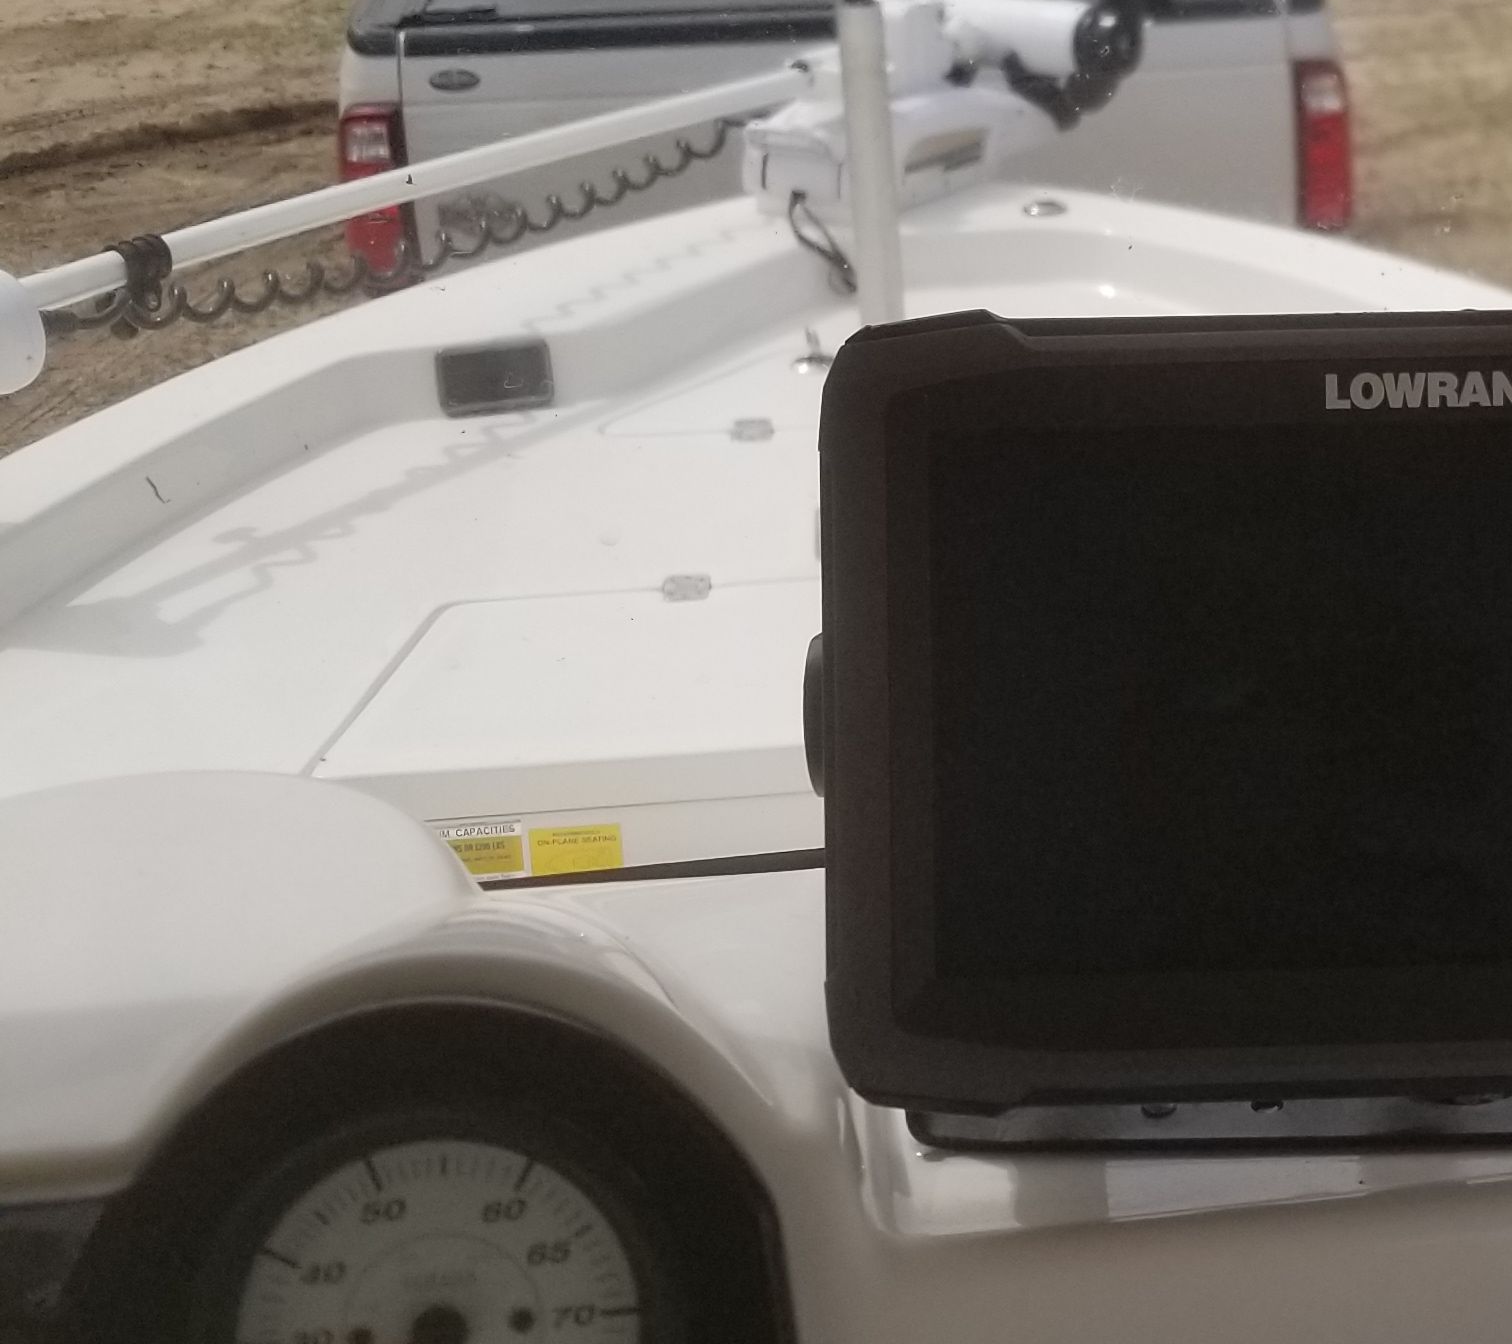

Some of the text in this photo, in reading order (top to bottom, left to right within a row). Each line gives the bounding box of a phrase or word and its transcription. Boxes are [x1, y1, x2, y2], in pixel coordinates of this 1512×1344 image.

[455, 824, 516, 837] CAPACITIES
[360, 1198, 407, 1225] 50
[481, 1198, 528, 1224] 60
[526, 1241, 571, 1266] 65
[300, 1261, 347, 1286] 40
[553, 1304, 596, 1327] 70
